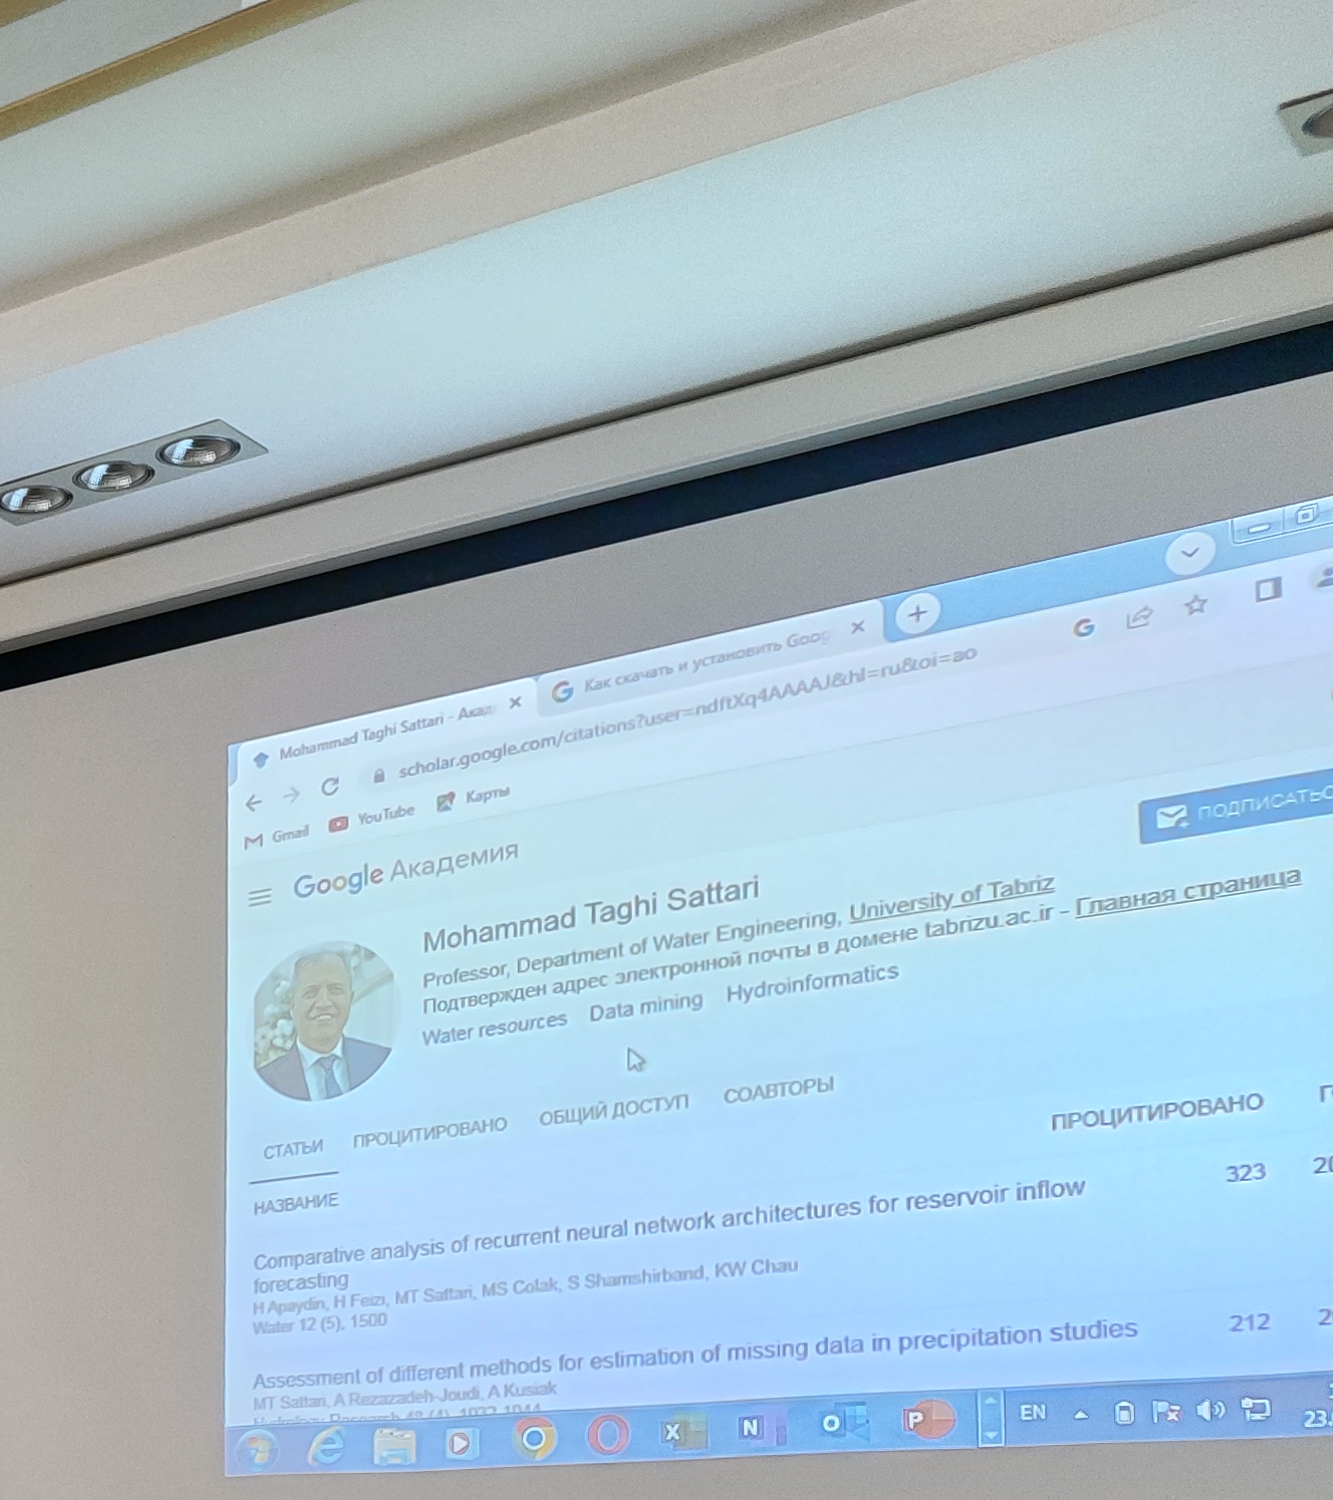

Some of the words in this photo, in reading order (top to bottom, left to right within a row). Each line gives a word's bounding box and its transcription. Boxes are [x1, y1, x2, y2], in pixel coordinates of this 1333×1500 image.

[584, 677, 611, 692] Как
[615, 664, 674, 686] скачать
[678, 661, 689, 672] и
[692, 641, 782, 673] установить
[280, 732, 358, 760] Mohammad
[362, 723, 396, 743] Taghi
[401, 712, 444, 733] Sattari
[272, 825, 310, 843] Gmail
[358, 805, 415, 825] YouTube
[466, 787, 510, 804] Карты
[293, 863, 384, 898] Google
[390, 844, 518, 882] Академия
[423, 906, 576, 953] Mohammad
[585, 892, 658, 926] Taghi
[667, 875, 760, 912] Sattari
[423, 964, 511, 989] Professor,
[517, 940, 624, 974] Department
[630, 937, 647, 955] of
[653, 931, 710, 952] Water
[717, 909, 842, 943] Engineering,
[849, 891, 954, 921] University
[961, 884, 982, 904] of
[988, 874, 1055, 899] Tabriz
[423, 984, 547, 1014] Подтвержден
[553, 973, 608, 996] адрес
[615, 950, 742, 985] электронной
[748, 943, 811, 965] почты
[817, 940, 829, 954] в
[835, 927, 918, 954] домене
[924, 904, 1054, 939] tabrizu.ac.ir
[1075, 888, 1175, 918] Главная
[1184, 869, 1302, 901] страница
[422, 1028, 474, 1047] Water
[479, 1013, 568, 1039] resources
[589, 1000, 634, 1022] Data
[640, 992, 703, 1015] mining
[727, 964, 900, 1003] Hydroinformatics
[264, 1139, 324, 1160] СТАТЬИ
[353, 1117, 508, 1149] ПРОЦИТИРОВАНО
[540, 1101, 608, 1126] ОБЩИЙ
[612, 1094, 690, 1120] ДОСТУП
[724, 1076, 834, 1104] СОАВТОРЫ
[1052, 1093, 1264, 1131] ПРОЦИТИРОВАНО
[1226, 1163, 1267, 1183] 323
[254, 1192, 339, 1216] НАЗВАНИЕ
[254, 1245, 365, 1271] Comparative
[371, 1238, 445, 1262] analysis
[451, 1235, 471, 1253] of
[475, 1226, 561, 1251] recurrent
[566, 1219, 629, 1242] neural
[634, 1211, 716, 1236] network
[722, 1200, 861, 1229] architectures
[869, 1195, 899, 1214] for
[906, 1184, 1010, 1211] reservoir
[1016, 1179, 1086, 1203] inflow
[253, 1302, 264, 1316] H
[334, 1294, 346, 1309] H
[396, 1289, 419, 1305] MT
[423, 1285, 474, 1304] Sattari,
[483, 1280, 508, 1297] MS
[513, 1277, 562, 1296] Colak,
[568, 1275, 580, 1290] S
[585, 1264, 709, 1289] Shamshirband,
[715, 1261, 747, 1279] KW
[751, 1258, 799, 1276] Chau
[254, 1273, 349, 1294] forecasting
[253, 1321, 294, 1335] Water
[299, 1317, 317, 1331] 12
[351, 1312, 388, 1328] 1500
[1229, 1312, 1271, 1332] 212
[253, 1369, 361, 1390] Assessment
[366, 1366, 385, 1384] of
[390, 1362, 464, 1383] different
[470, 1356, 552, 1378] methods
[558, 1354, 584, 1372] for
[591, 1349, 694, 1370] estimation
[701, 1344, 722, 1362] of
[727, 1340, 809, 1361] missing
[816, 1335, 864, 1355] data
[872, 1333, 891, 1352] in
[899, 1325, 1042, 1355] precipitation
[1050, 1319, 1139, 1342] studies
[254, 1396, 277, 1411] MT
[334, 1392, 346, 1407] A
[488, 1384, 501, 1399] A
[504, 1380, 558, 1398] Kusiak
[1019, 1404, 1047, 1422] EN
